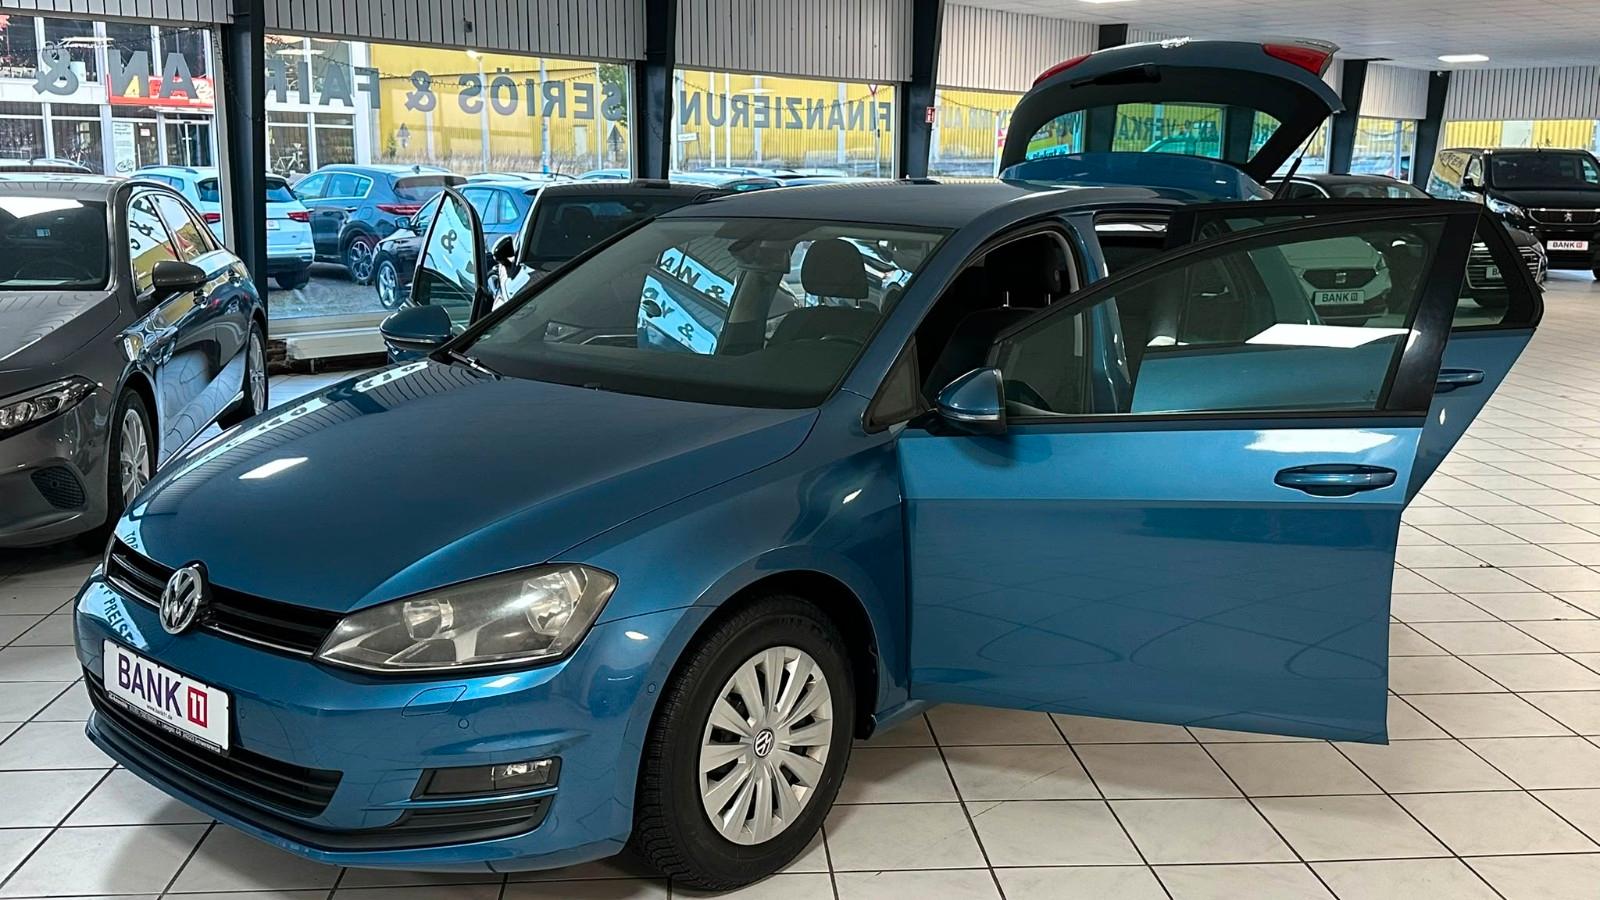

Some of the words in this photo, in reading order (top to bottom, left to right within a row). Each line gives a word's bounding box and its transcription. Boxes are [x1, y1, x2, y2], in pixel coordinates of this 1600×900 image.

[1552, 241, 1575, 249] BANK
[1322, 292, 1349, 303] BANK
[118, 652, 182, 718] BANK
[189, 690, 206, 725] 11
